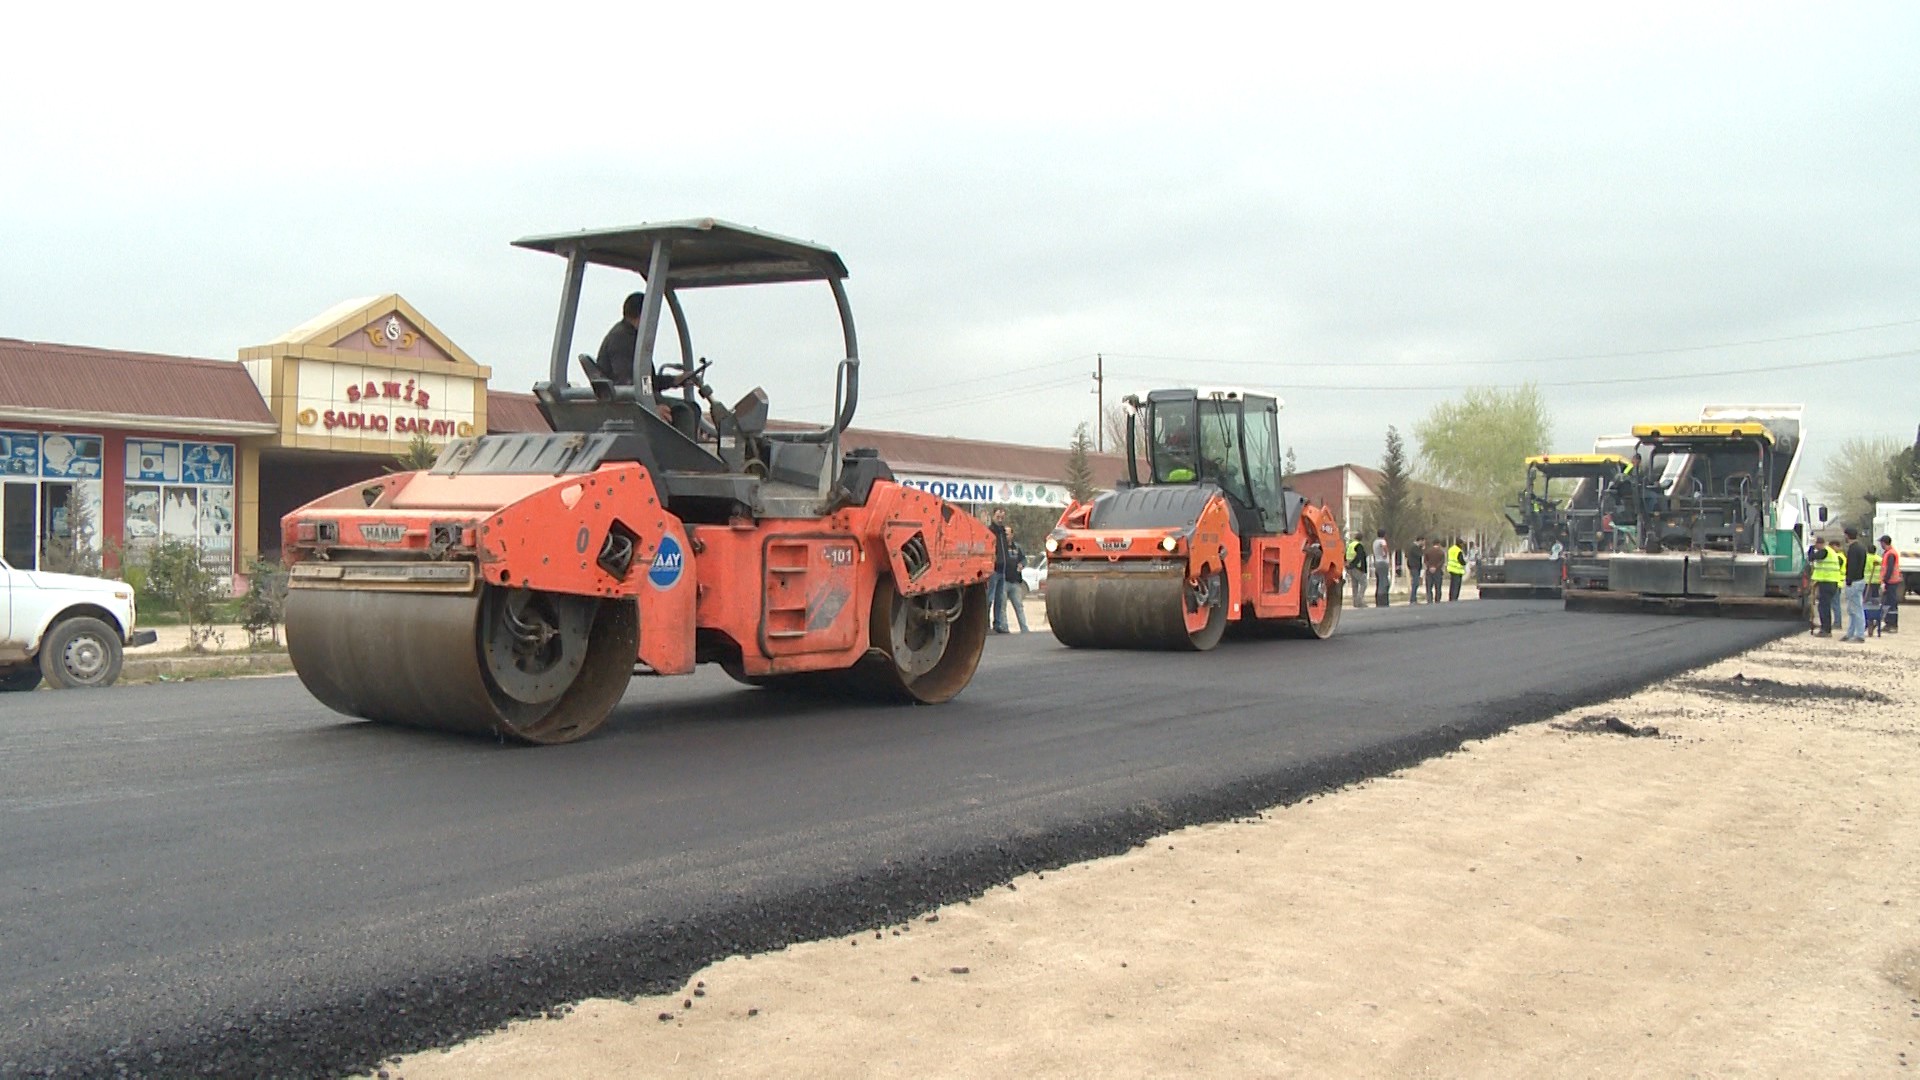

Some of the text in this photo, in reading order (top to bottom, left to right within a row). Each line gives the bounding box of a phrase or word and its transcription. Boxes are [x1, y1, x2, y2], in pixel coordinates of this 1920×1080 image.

[346, 378, 431, 410] SAMİR
[395, 416, 455, 437] SARAYI
[895, 479, 994, 501] TORANI
[366, 527, 400, 540] HAMM
